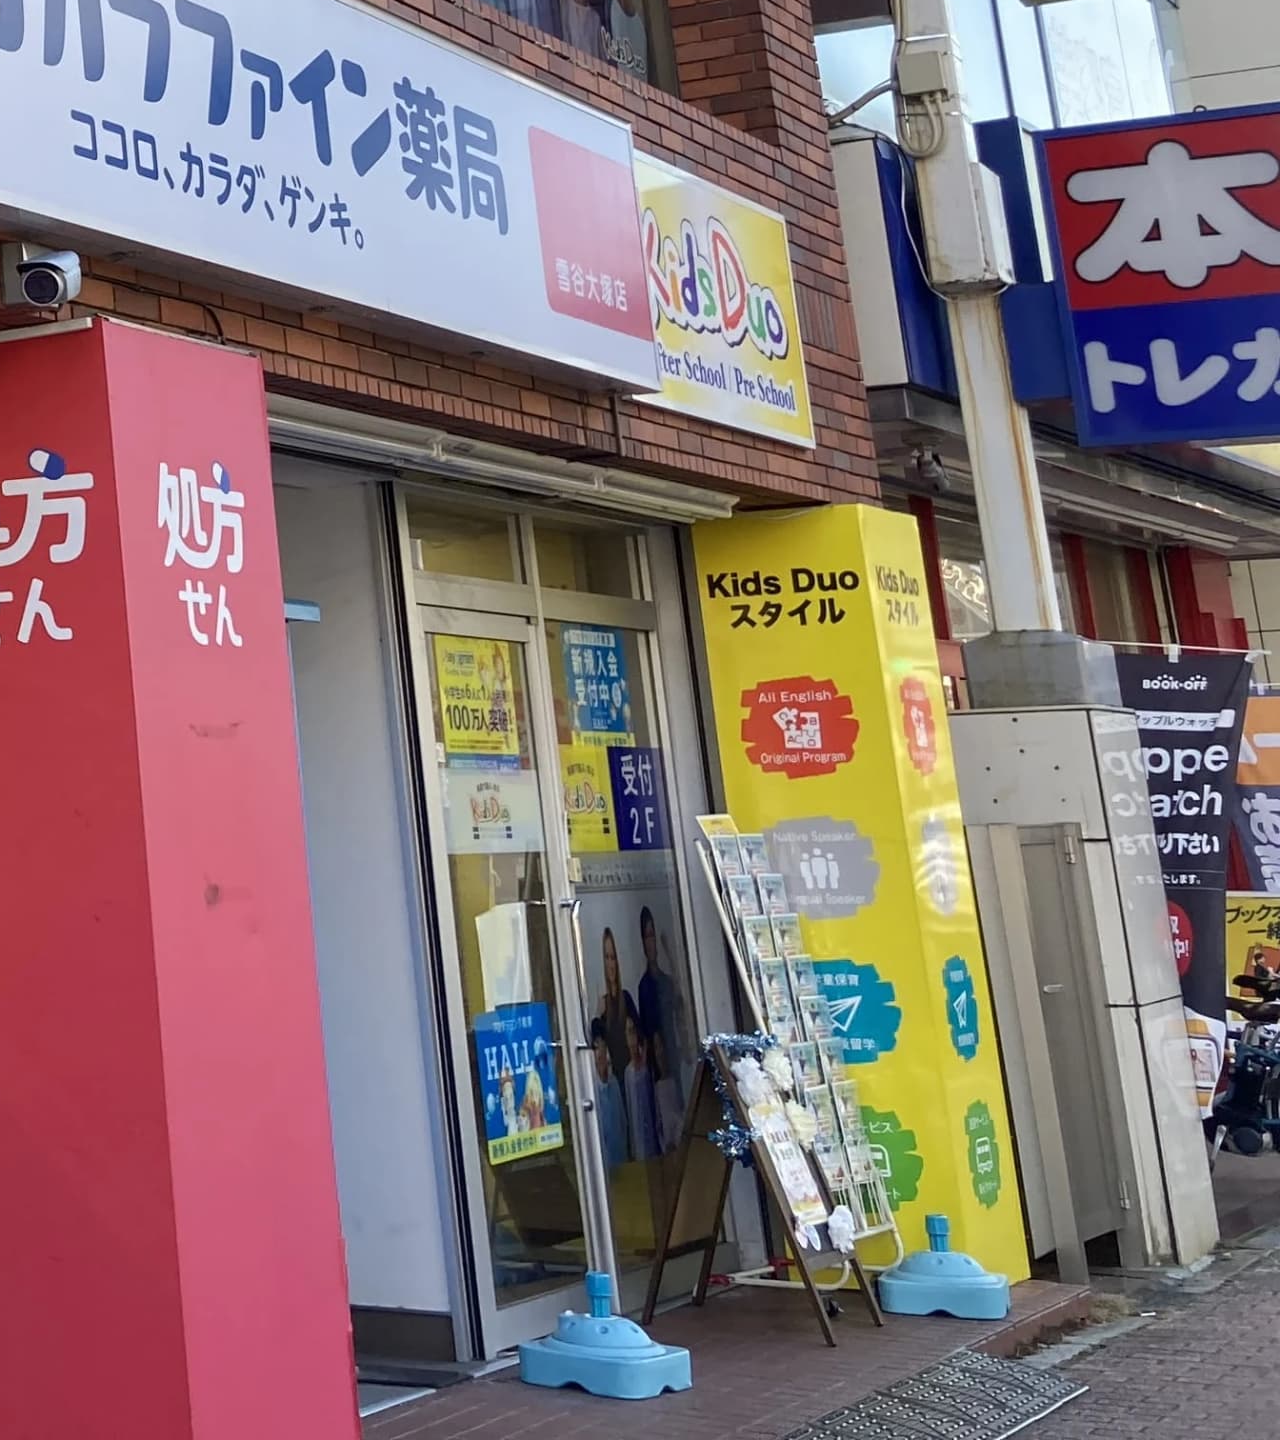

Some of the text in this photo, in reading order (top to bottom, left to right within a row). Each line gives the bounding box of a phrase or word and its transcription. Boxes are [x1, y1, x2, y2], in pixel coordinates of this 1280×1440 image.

[72, 107, 367, 252] ココロ、カラダ、ゲンキ。
[1067, 139, 1280, 288] 本
[555, 257, 628, 313] 雪谷大塚店
[683, 351, 727, 390] School
[733, 366, 757, 398] Pre
[756, 375, 796, 412] School
[157, 461, 245, 574] 処方
[706, 567, 860, 599] Kids Duo
[874, 565, 899, 594] Kids
[898, 568, 920, 598] Duo
[178, 578, 243, 647] せん
[729, 597, 846, 630] スタイル
[757, 690, 832, 704] All English
[620, 753, 654, 797] 受付
[760, 750, 847, 766] Original Program
